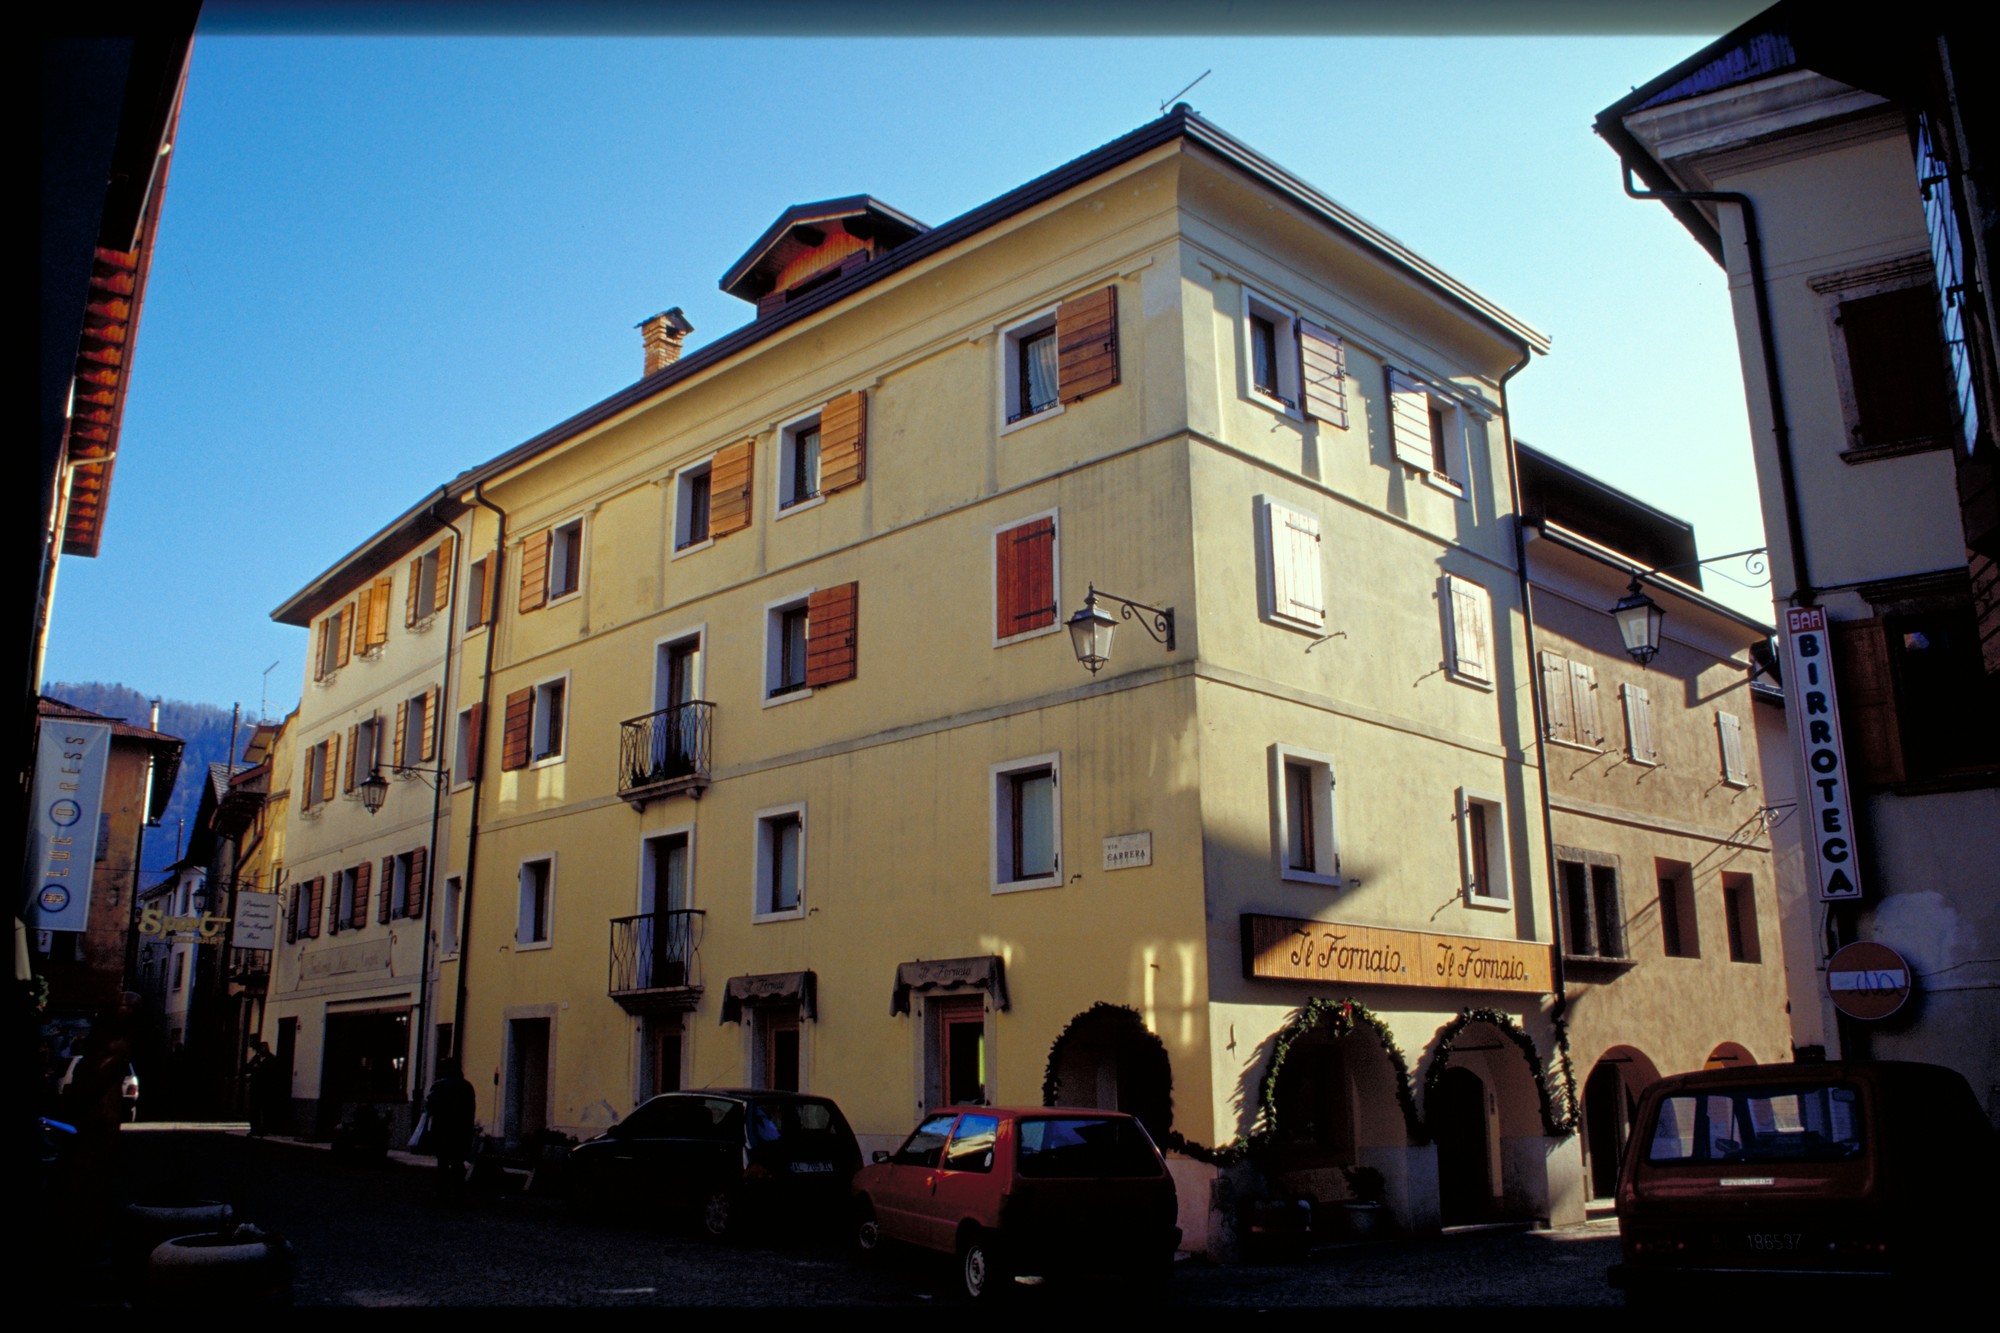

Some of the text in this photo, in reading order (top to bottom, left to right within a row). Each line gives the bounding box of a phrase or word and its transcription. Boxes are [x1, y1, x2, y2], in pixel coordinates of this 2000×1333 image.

[1790, 609, 1823, 631] BAR
[56, 736, 86, 818] DRESS
[1798, 633, 1854, 894] BIRROTECA
[1107, 849, 1146, 861] CARRERA
[138, 909, 232, 940] Sport
[1291, 928, 1402, 974] Il Fornaio
[1437, 942, 1525, 981] Il Fornaio
[1747, 1233, 1802, 1250] 186537
